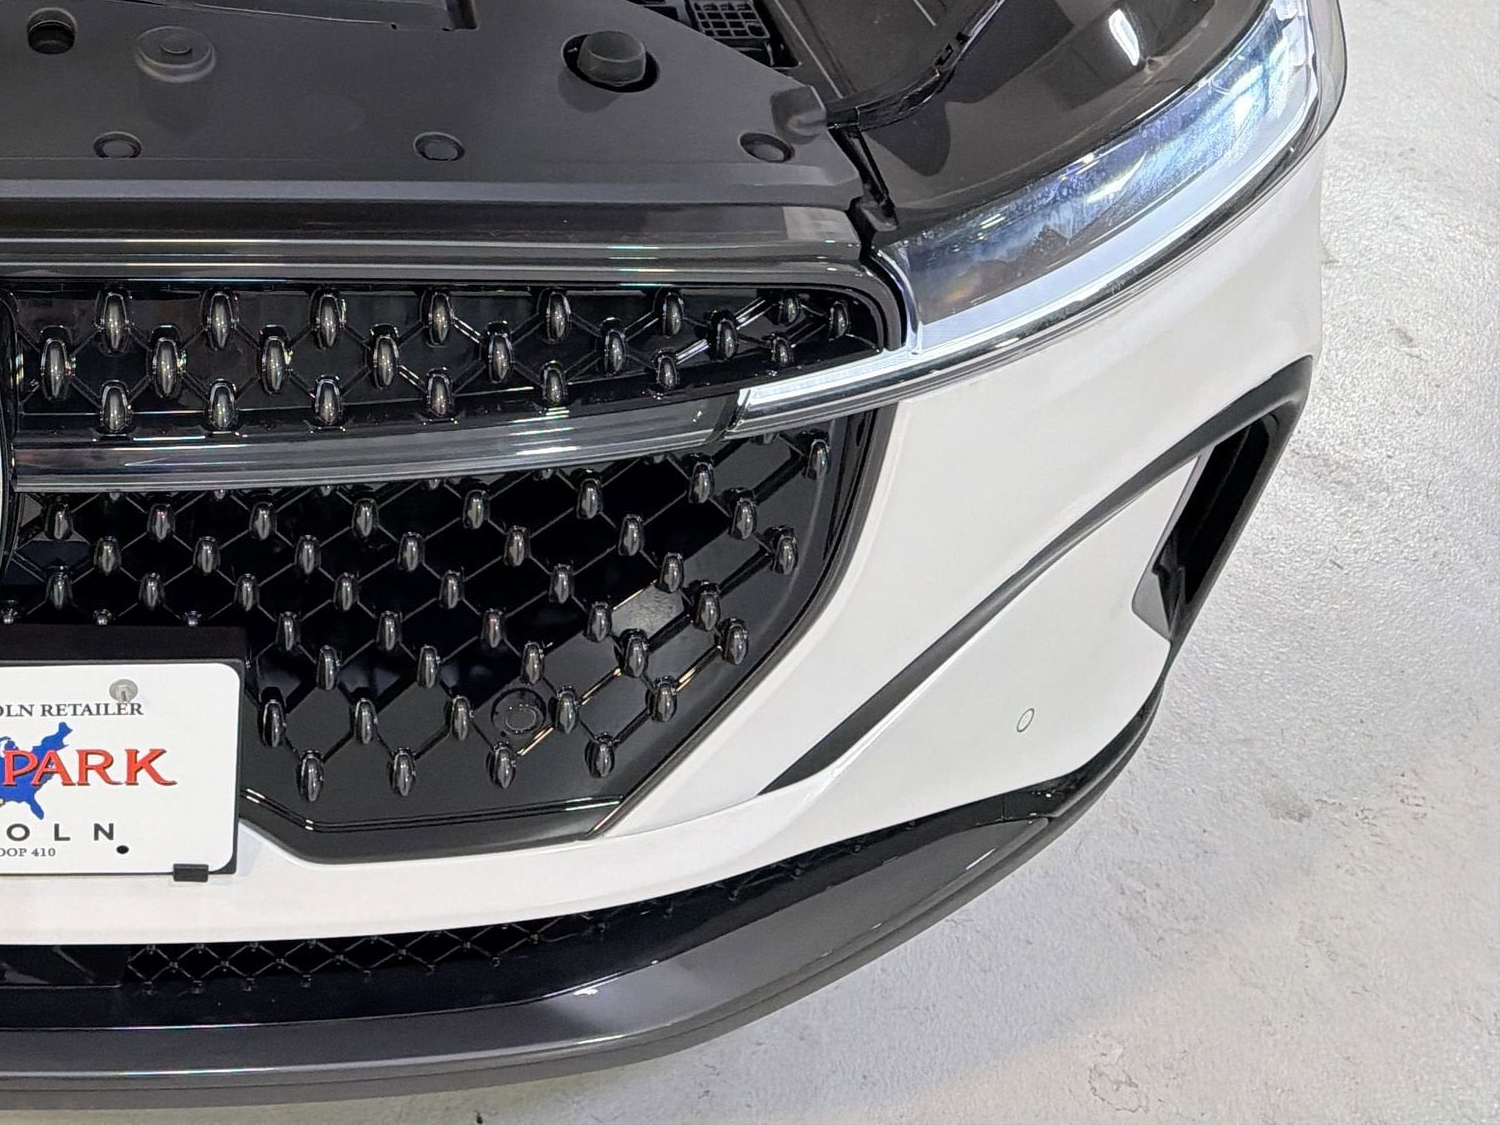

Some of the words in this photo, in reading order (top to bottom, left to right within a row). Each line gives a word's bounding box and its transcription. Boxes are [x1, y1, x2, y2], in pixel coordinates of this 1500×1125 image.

[40, 702, 144, 717] RETAILER
[3, 748, 178, 787] PARK
[31, 848, 56, 858] 410
